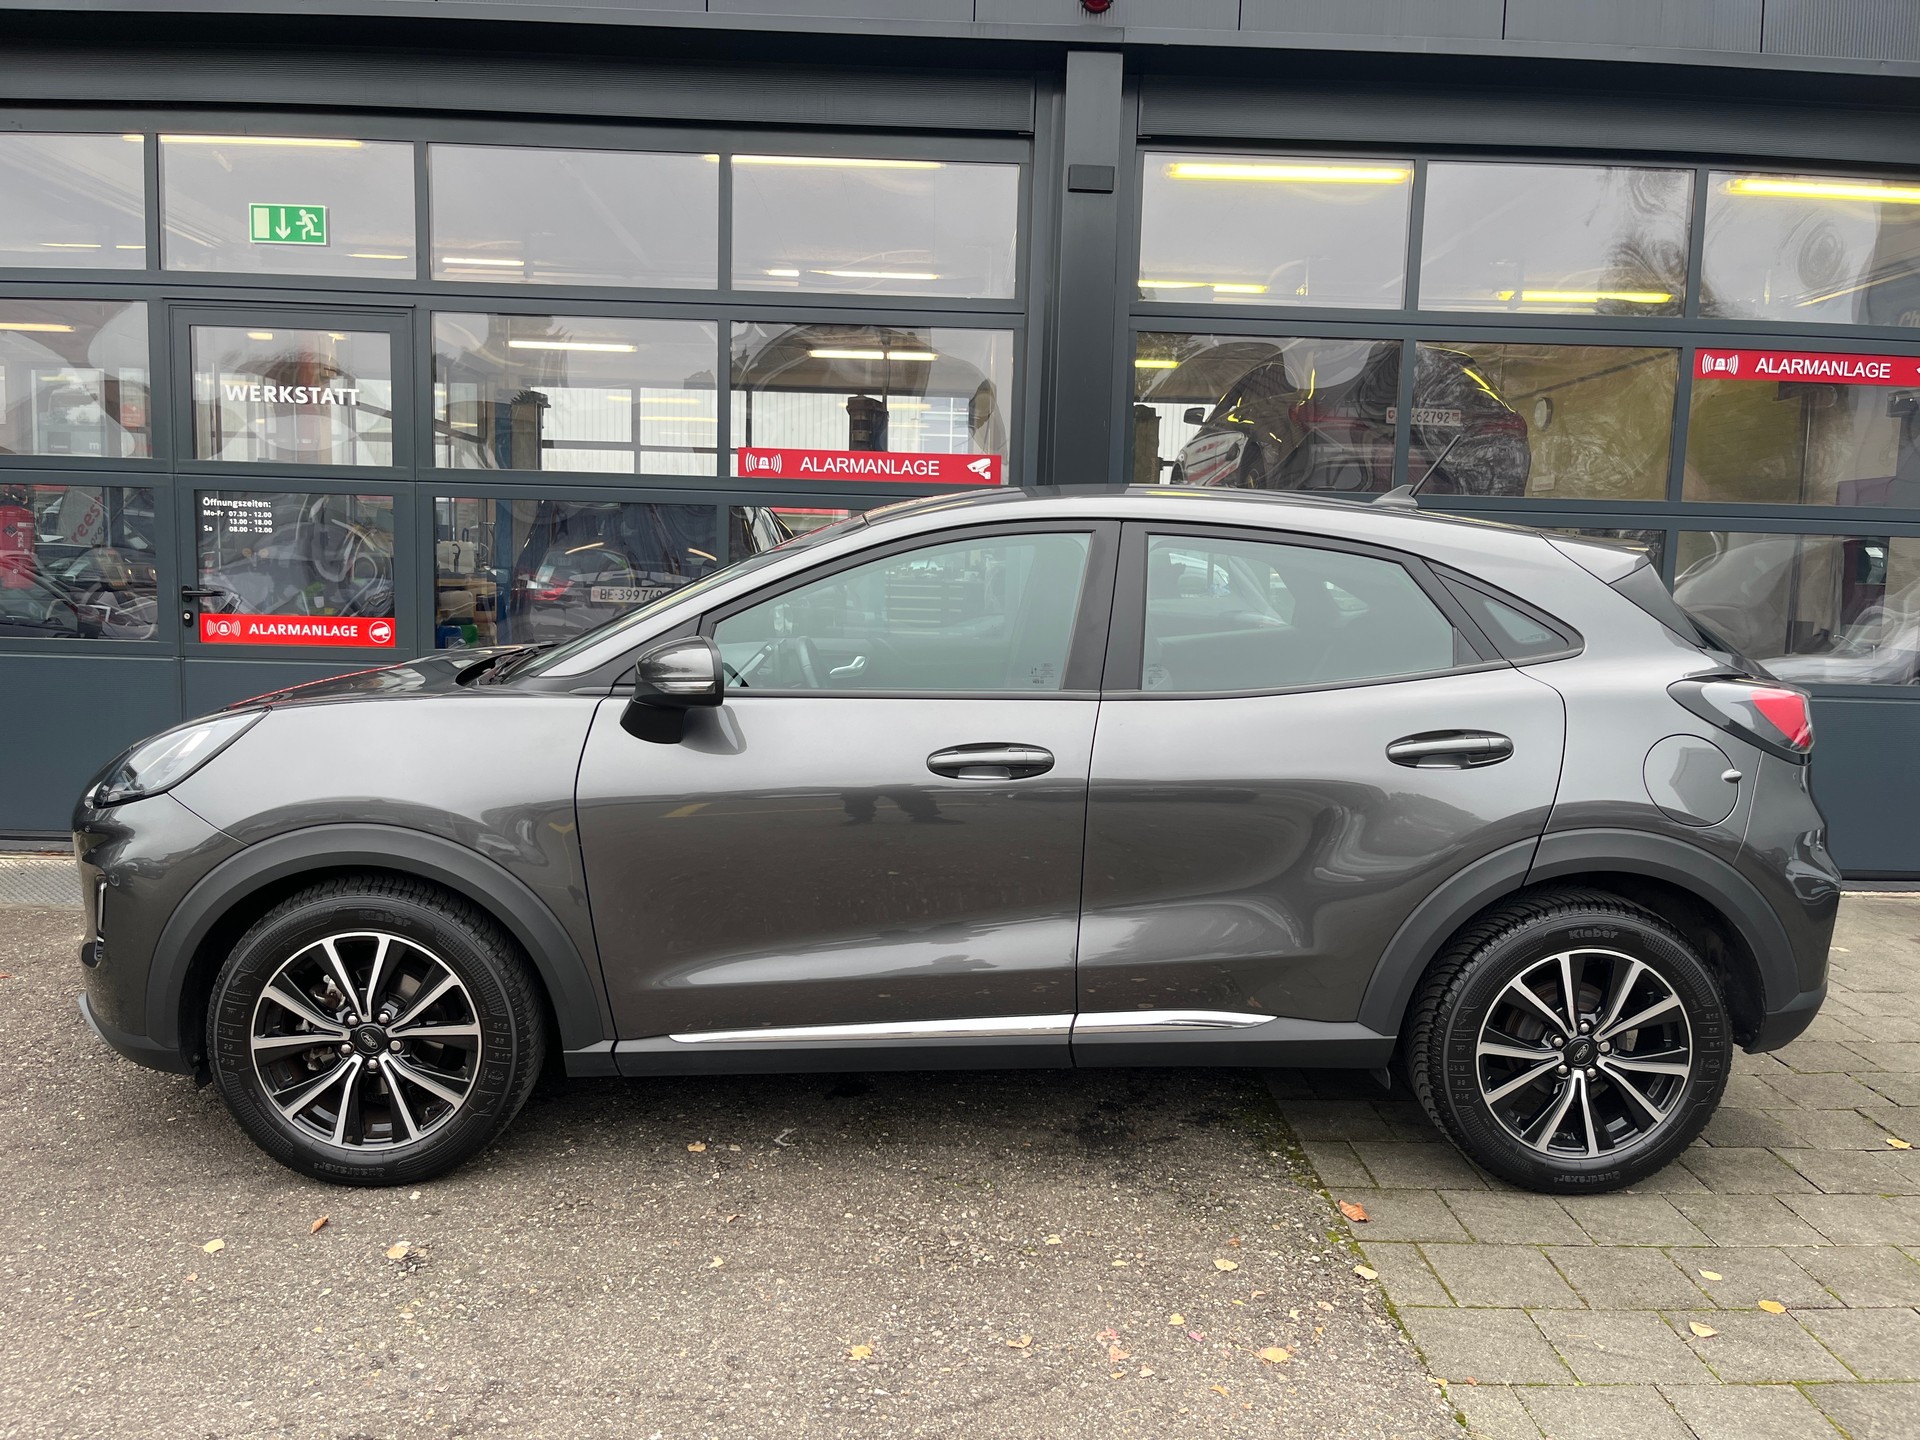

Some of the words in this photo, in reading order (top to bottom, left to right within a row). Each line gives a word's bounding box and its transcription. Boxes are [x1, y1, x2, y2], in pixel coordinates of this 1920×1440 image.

[1755, 357, 1891, 379] ALARMANLAGE
[225, 384, 360, 406] WERKSTATT
[800, 456, 940, 476] ALARMANLAGE
[203, 497, 272, 508] Öffnungszeiten:
[249, 623, 358, 637] ALARMANLAGE
[358, 910, 412, 927] Kleber
[1568, 928, 1619, 939] Kleber
